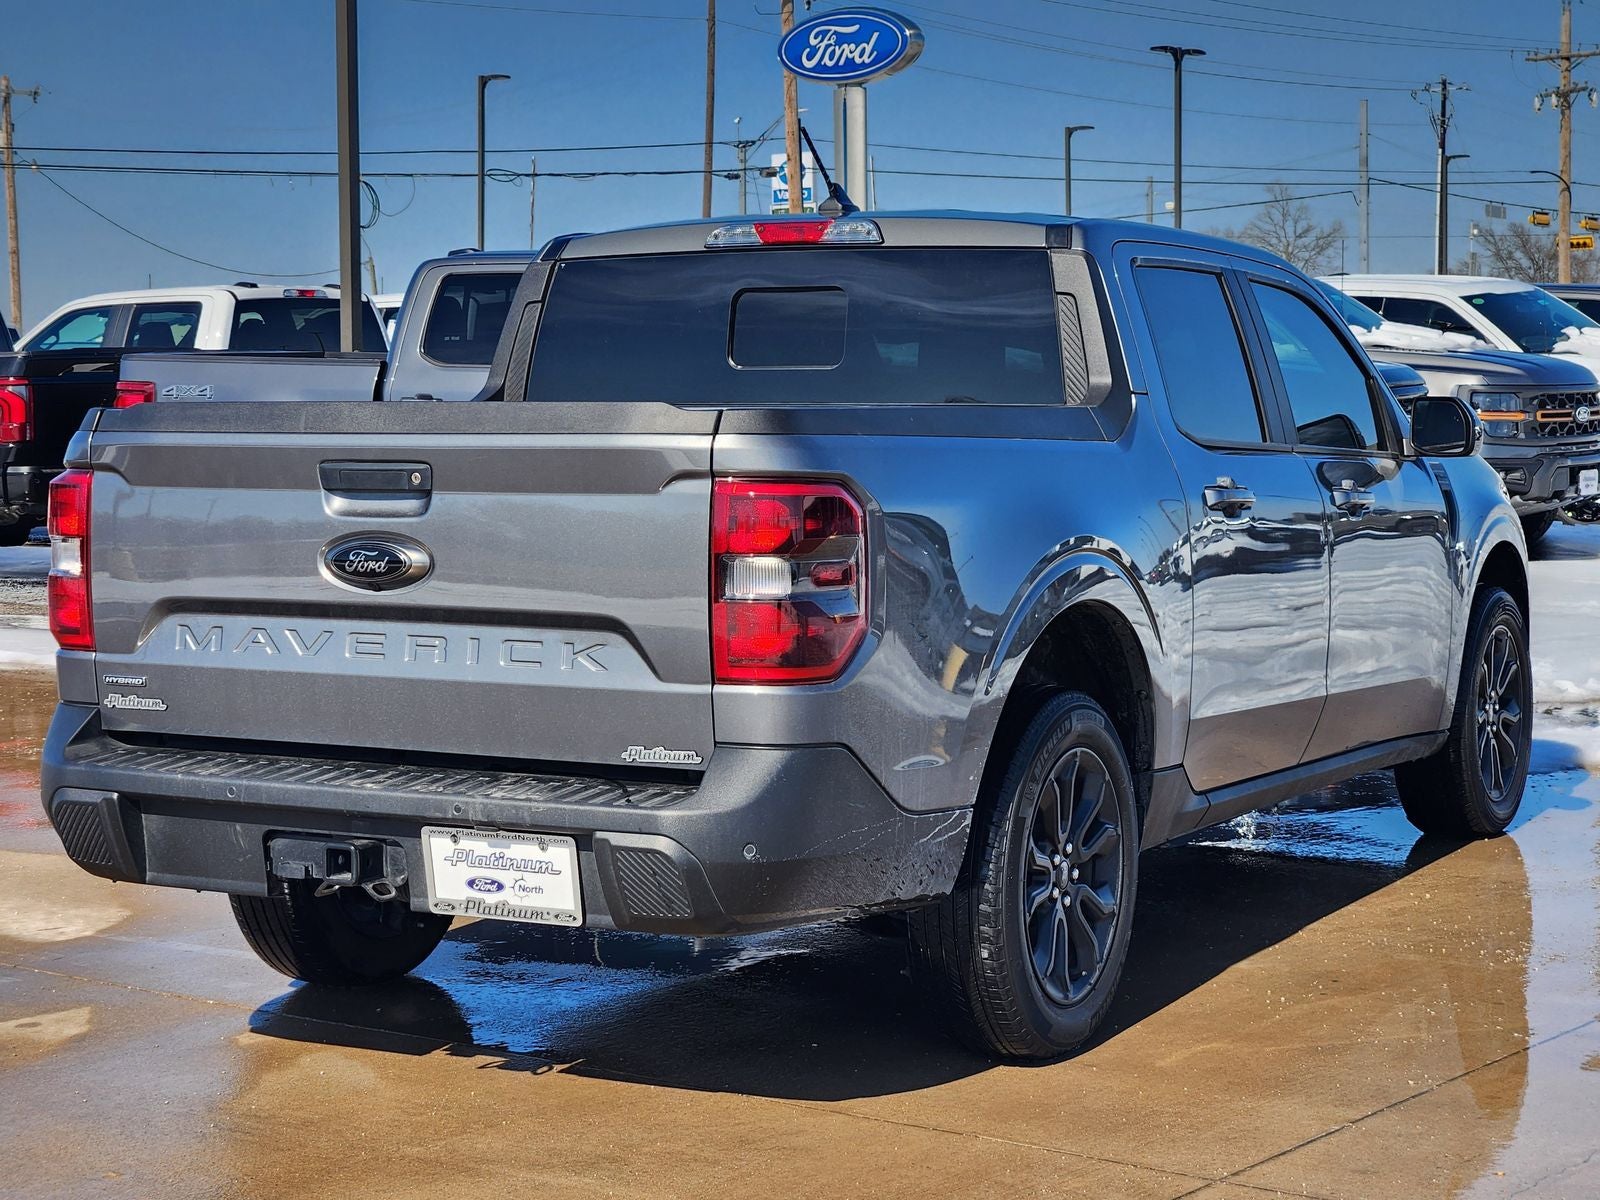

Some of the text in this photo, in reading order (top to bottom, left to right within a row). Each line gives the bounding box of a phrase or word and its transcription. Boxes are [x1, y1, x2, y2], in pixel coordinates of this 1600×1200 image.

[801, 24, 880, 69] Ford
[345, 549, 389, 573] Ford
[175, 623, 609, 672] MAVERICK
[105, 676, 143, 685] HYBRID
[104, 693, 168, 711] Platinum
[620, 745, 703, 764] Platinum
[1034, 718, 1073, 780] MICHELIN
[428, 828, 568, 845] www.PlatinumFordNorth.com
[444, 848, 562, 876] Platinum
[473, 878, 499, 892] Ford
[518, 883, 544, 895] North
[464, 899, 549, 921] Platinum
